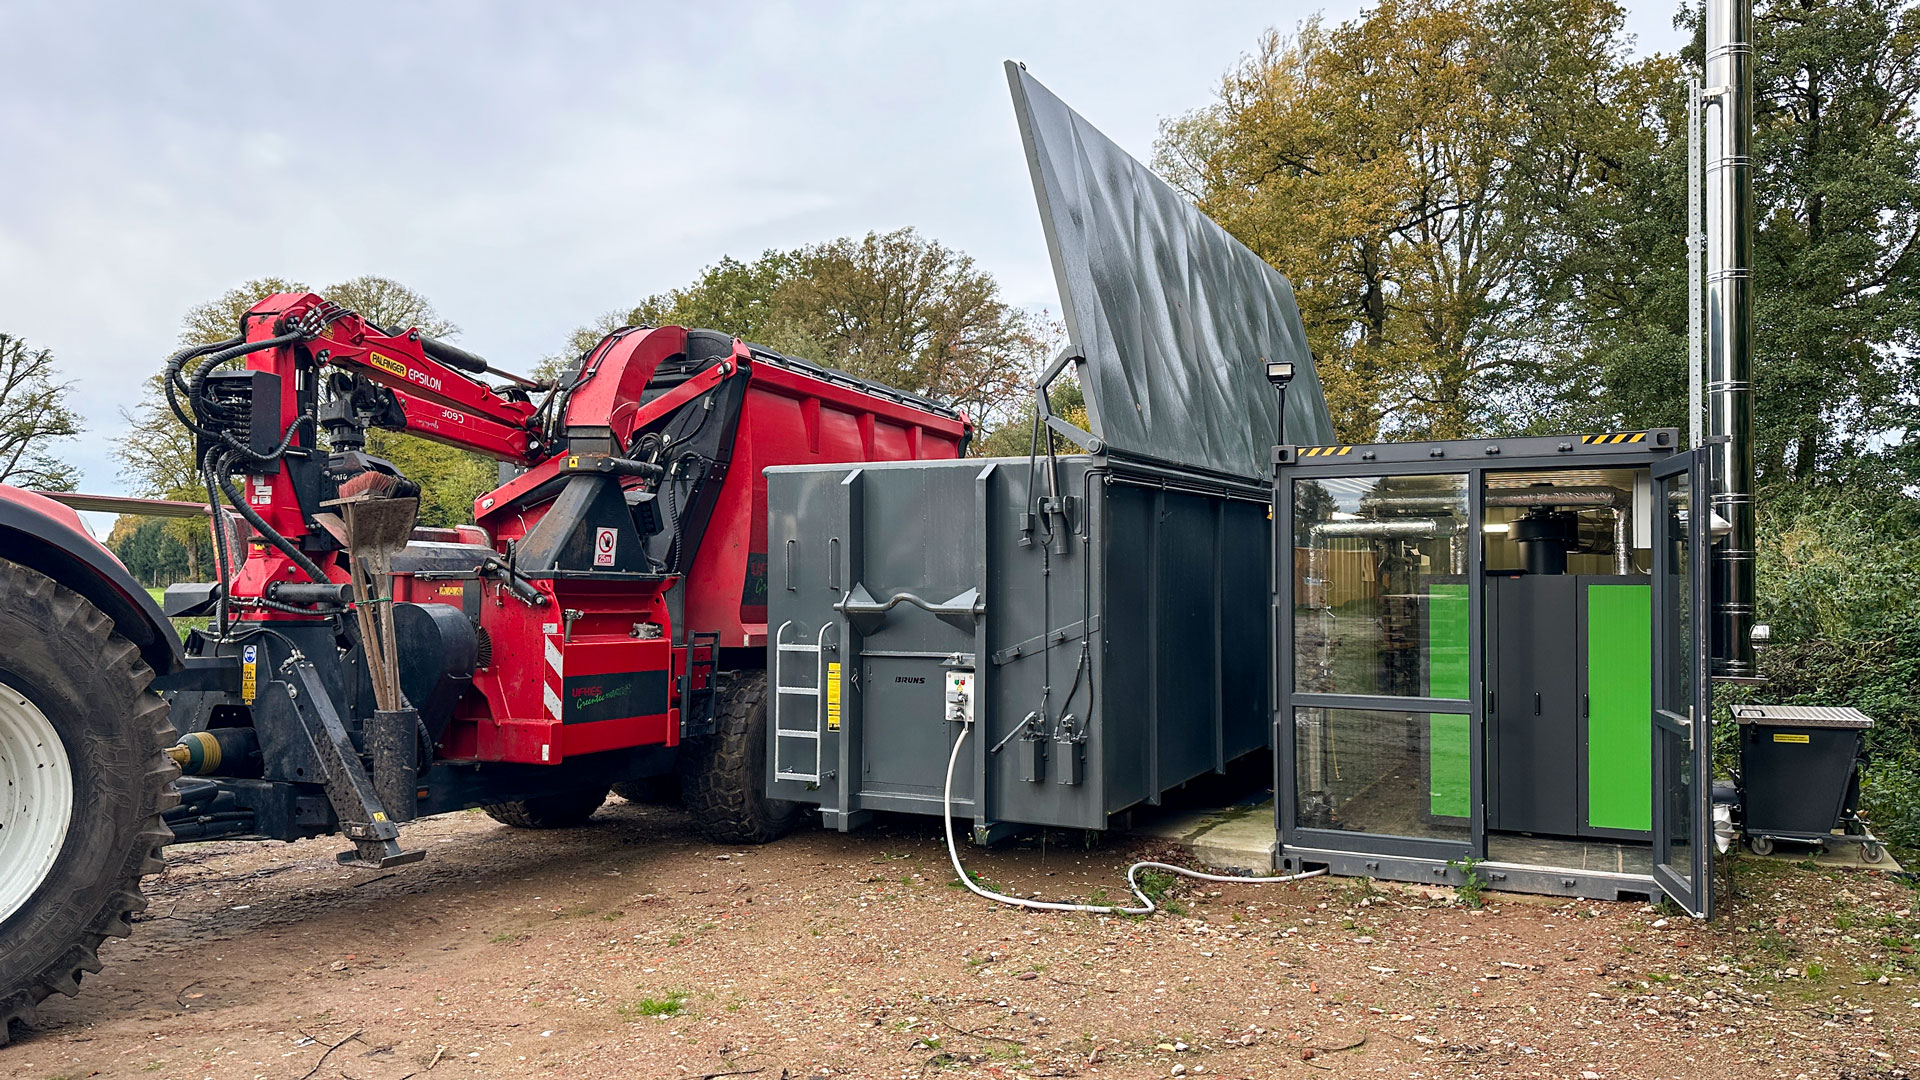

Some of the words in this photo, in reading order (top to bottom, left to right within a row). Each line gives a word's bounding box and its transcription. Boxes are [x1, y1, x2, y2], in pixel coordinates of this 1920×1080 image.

[372, 353, 405, 375] PALFINGER
[408, 368, 442, 391] EPSILON
[441, 409, 465, 424] C60F
[598, 555, 611, 563] 25m
[894, 676, 926, 684] BRUNS
